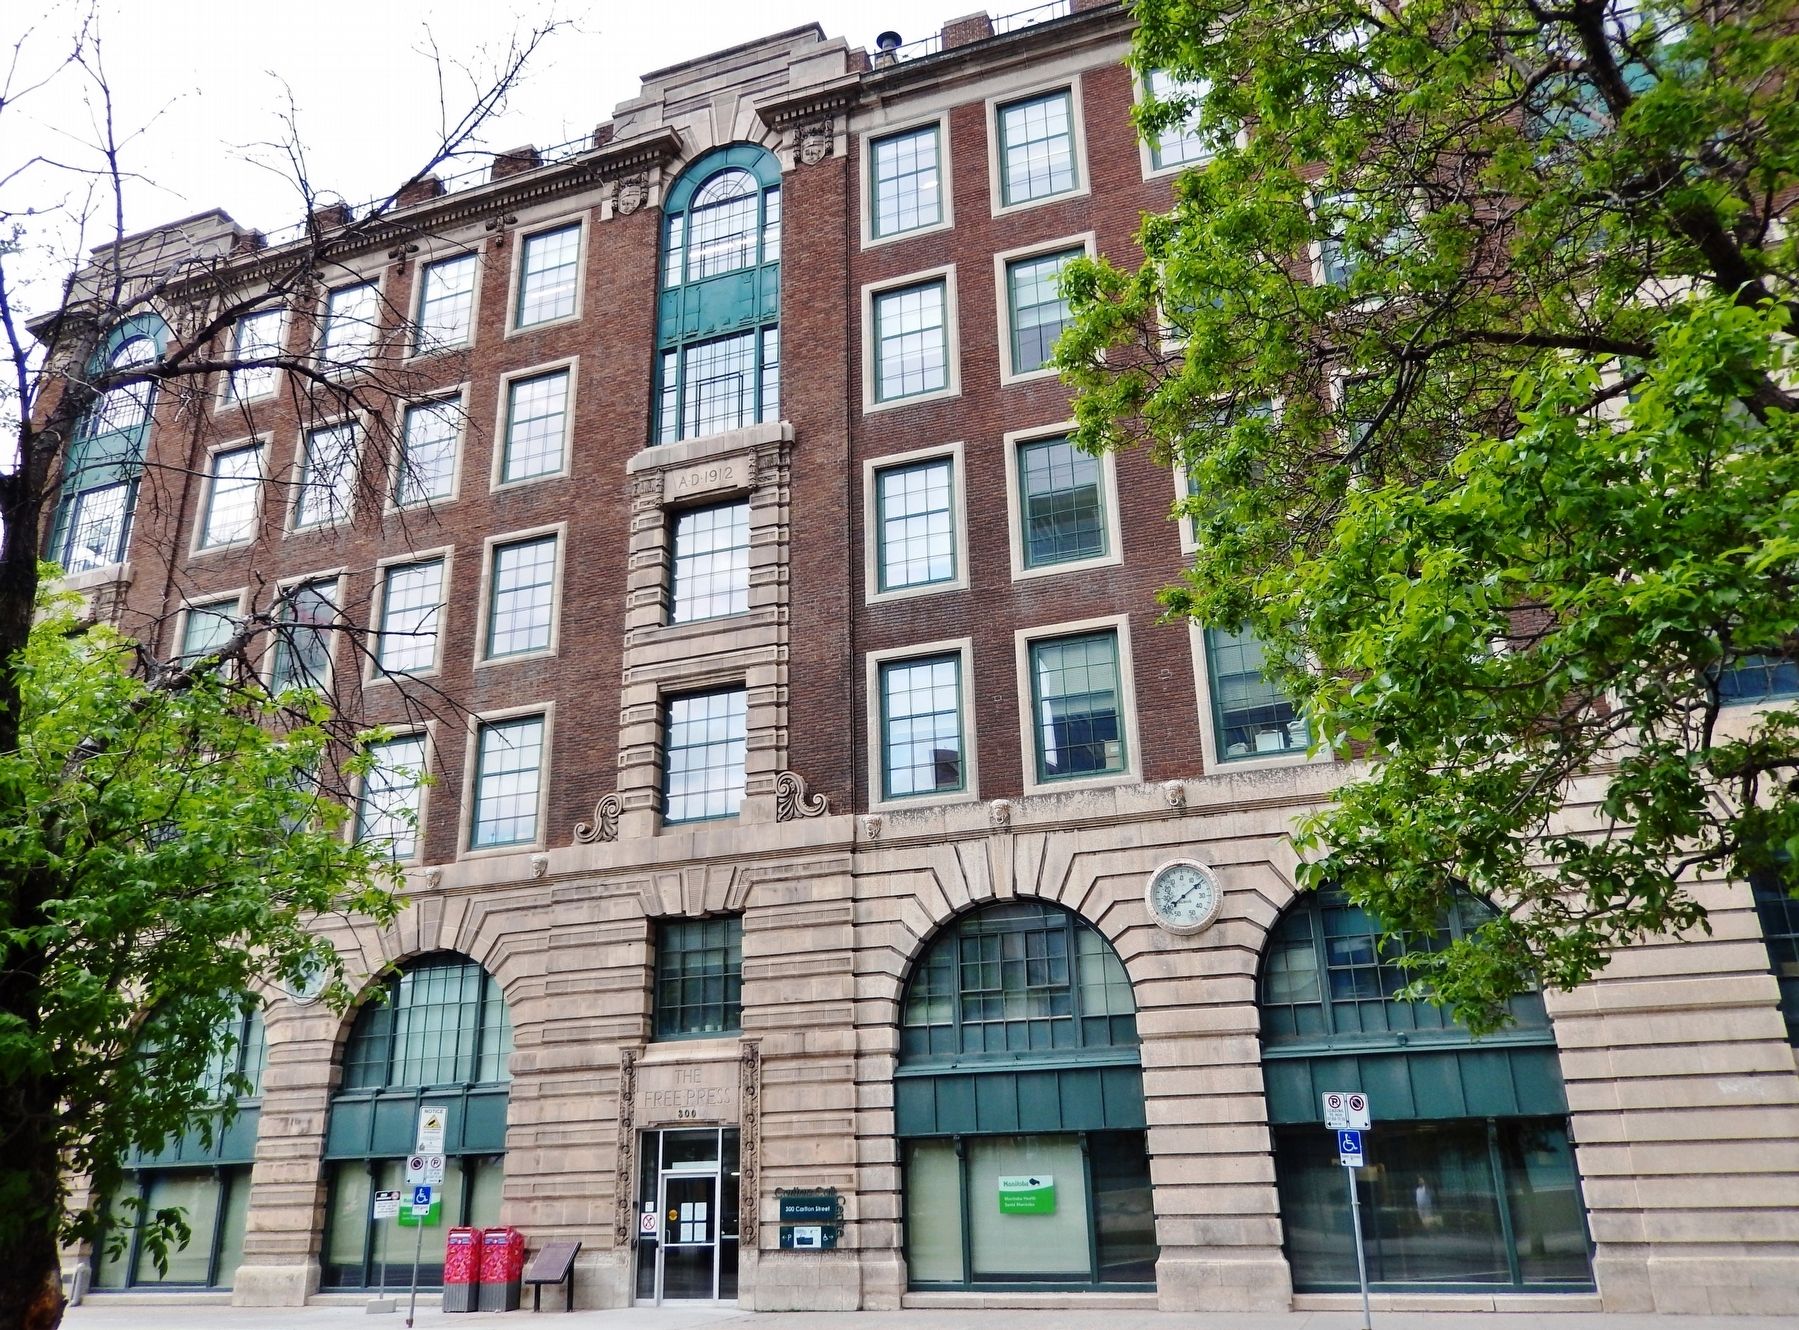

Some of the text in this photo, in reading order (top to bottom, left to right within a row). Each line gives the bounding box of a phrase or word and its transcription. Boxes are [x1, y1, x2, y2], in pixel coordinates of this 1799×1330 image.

[705, 466, 733, 483] 1912
[675, 1069, 702, 1084] THE
[644, 1087, 731, 1108] FREE PRESS
